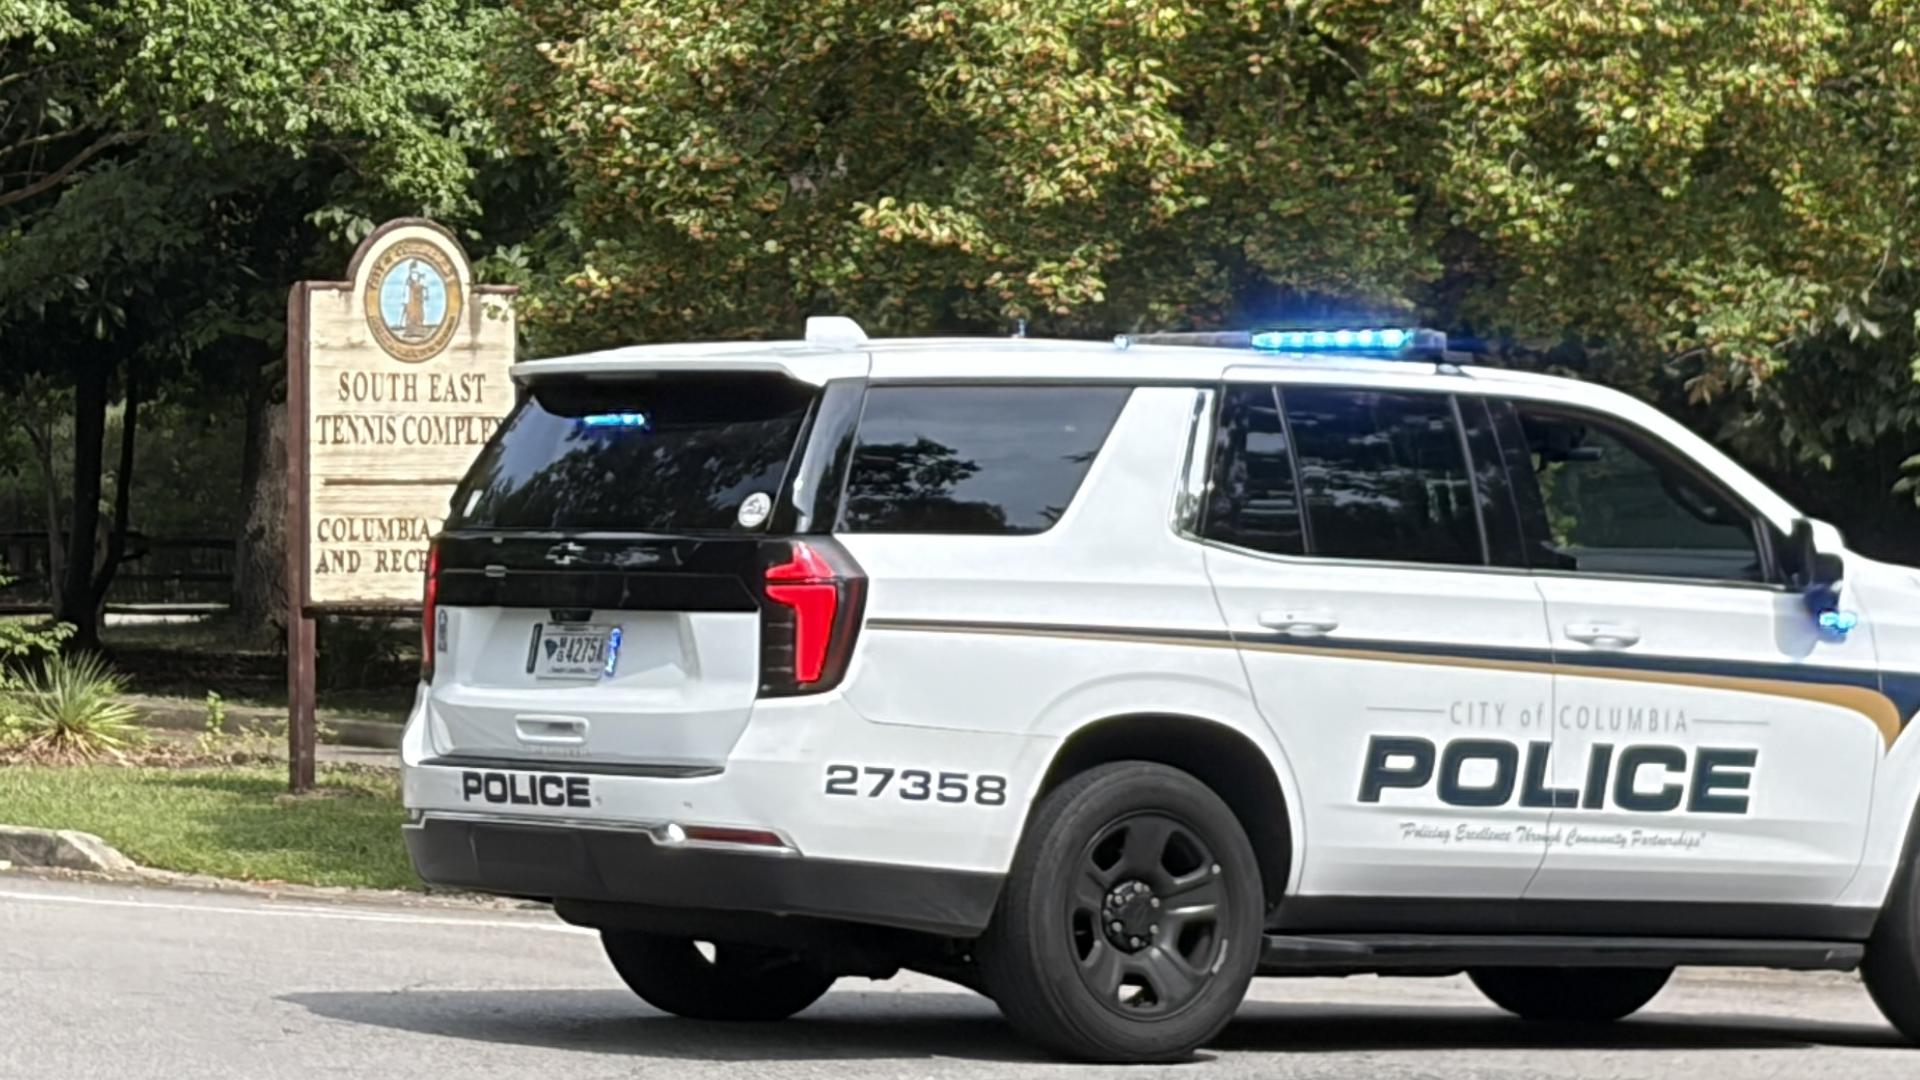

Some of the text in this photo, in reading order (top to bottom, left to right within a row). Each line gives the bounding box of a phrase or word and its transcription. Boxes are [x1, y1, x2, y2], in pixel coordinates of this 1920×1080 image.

[339, 372, 486, 404] SOUTH EAST
[316, 415, 396, 445] TENNIS
[317, 518, 432, 542] COLUMBIA
[315, 550, 361, 573] AND
[1450, 701, 1688, 732] CITY of COLUMBIA
[463, 772, 591, 807] POLICE
[825, 764, 1007, 806] 27358
[1357, 734, 1759, 814] POLICE
[1455, 824, 1511, 842] Excellence
[1516, 826, 1562, 846] Through
[1566, 827, 1627, 848] Community
